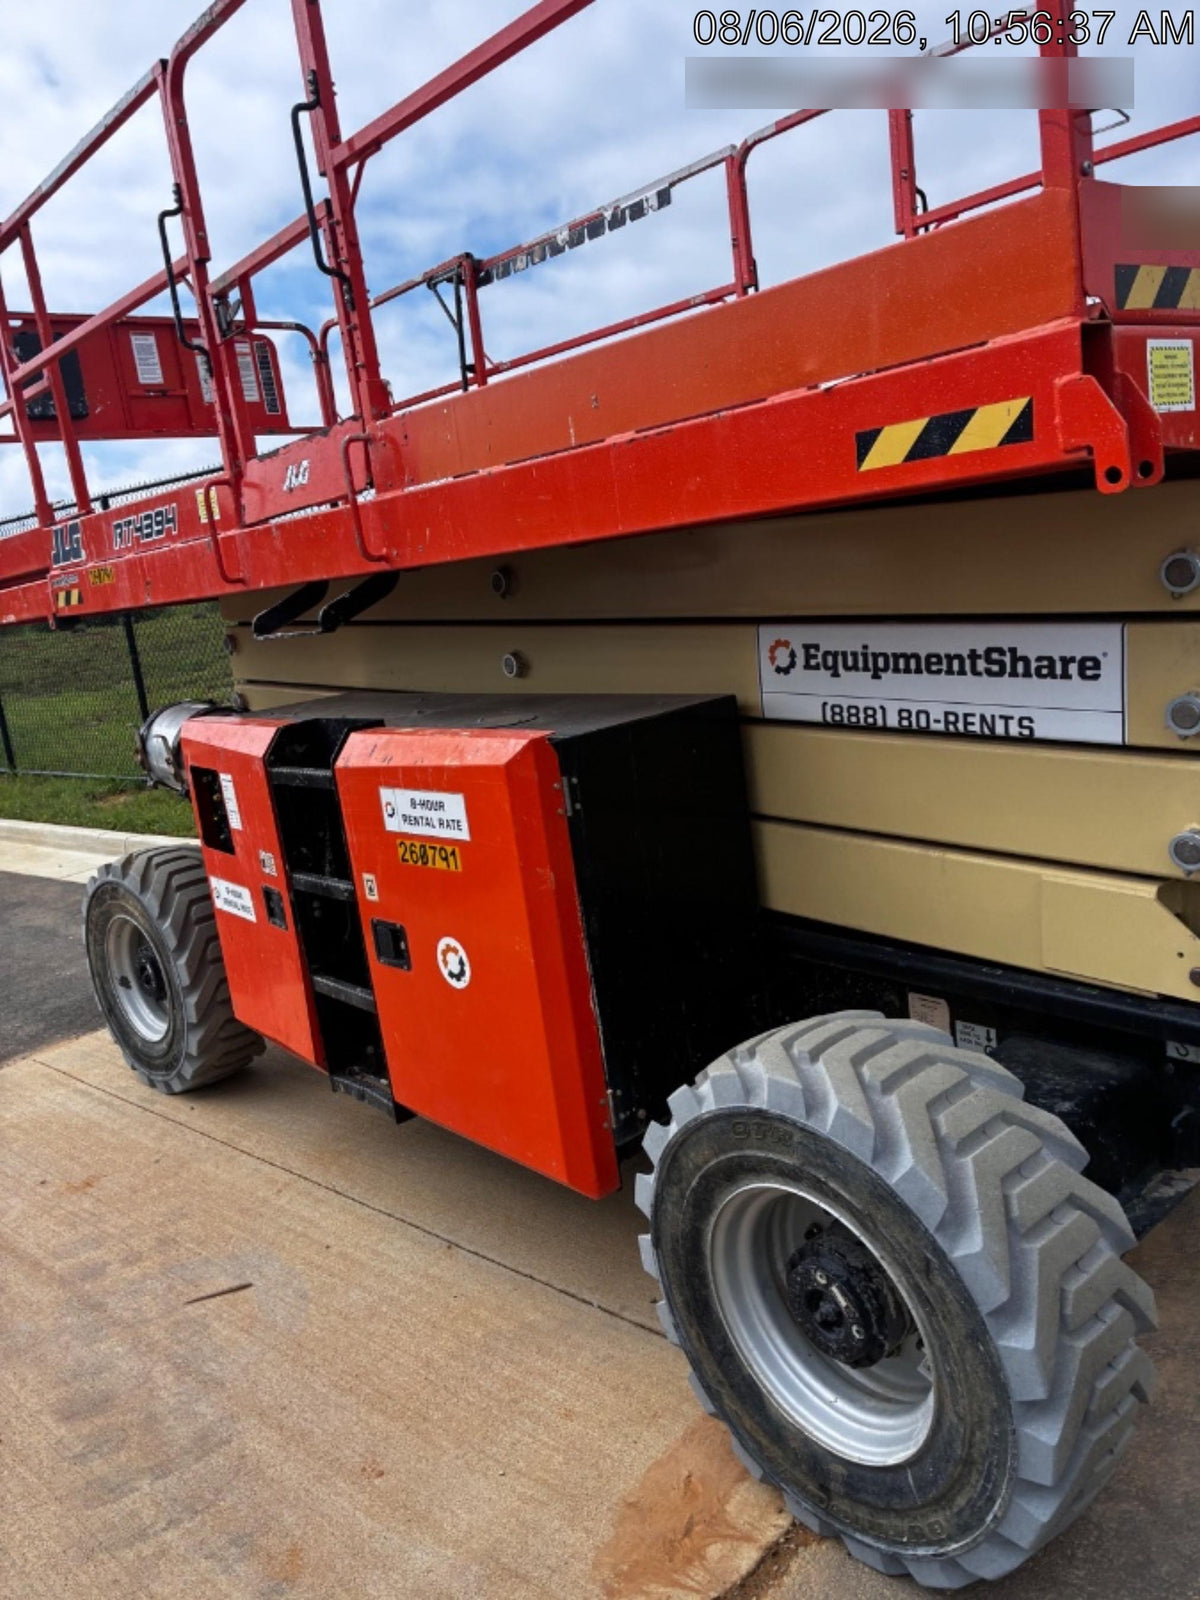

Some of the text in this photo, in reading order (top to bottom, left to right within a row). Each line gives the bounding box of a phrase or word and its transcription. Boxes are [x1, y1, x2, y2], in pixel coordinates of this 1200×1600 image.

[52, 520, 86, 568] JLG
[112, 502, 178, 550] RT4394
[801, 642, 1102, 681] EquipmentShare
[821, 701, 1035, 738] (888) 80-RENTS
[410, 797, 445, 812] 8-HOUR
[401, 813, 463, 832] RENTAL RATE
[398, 840, 459, 870] 260791
